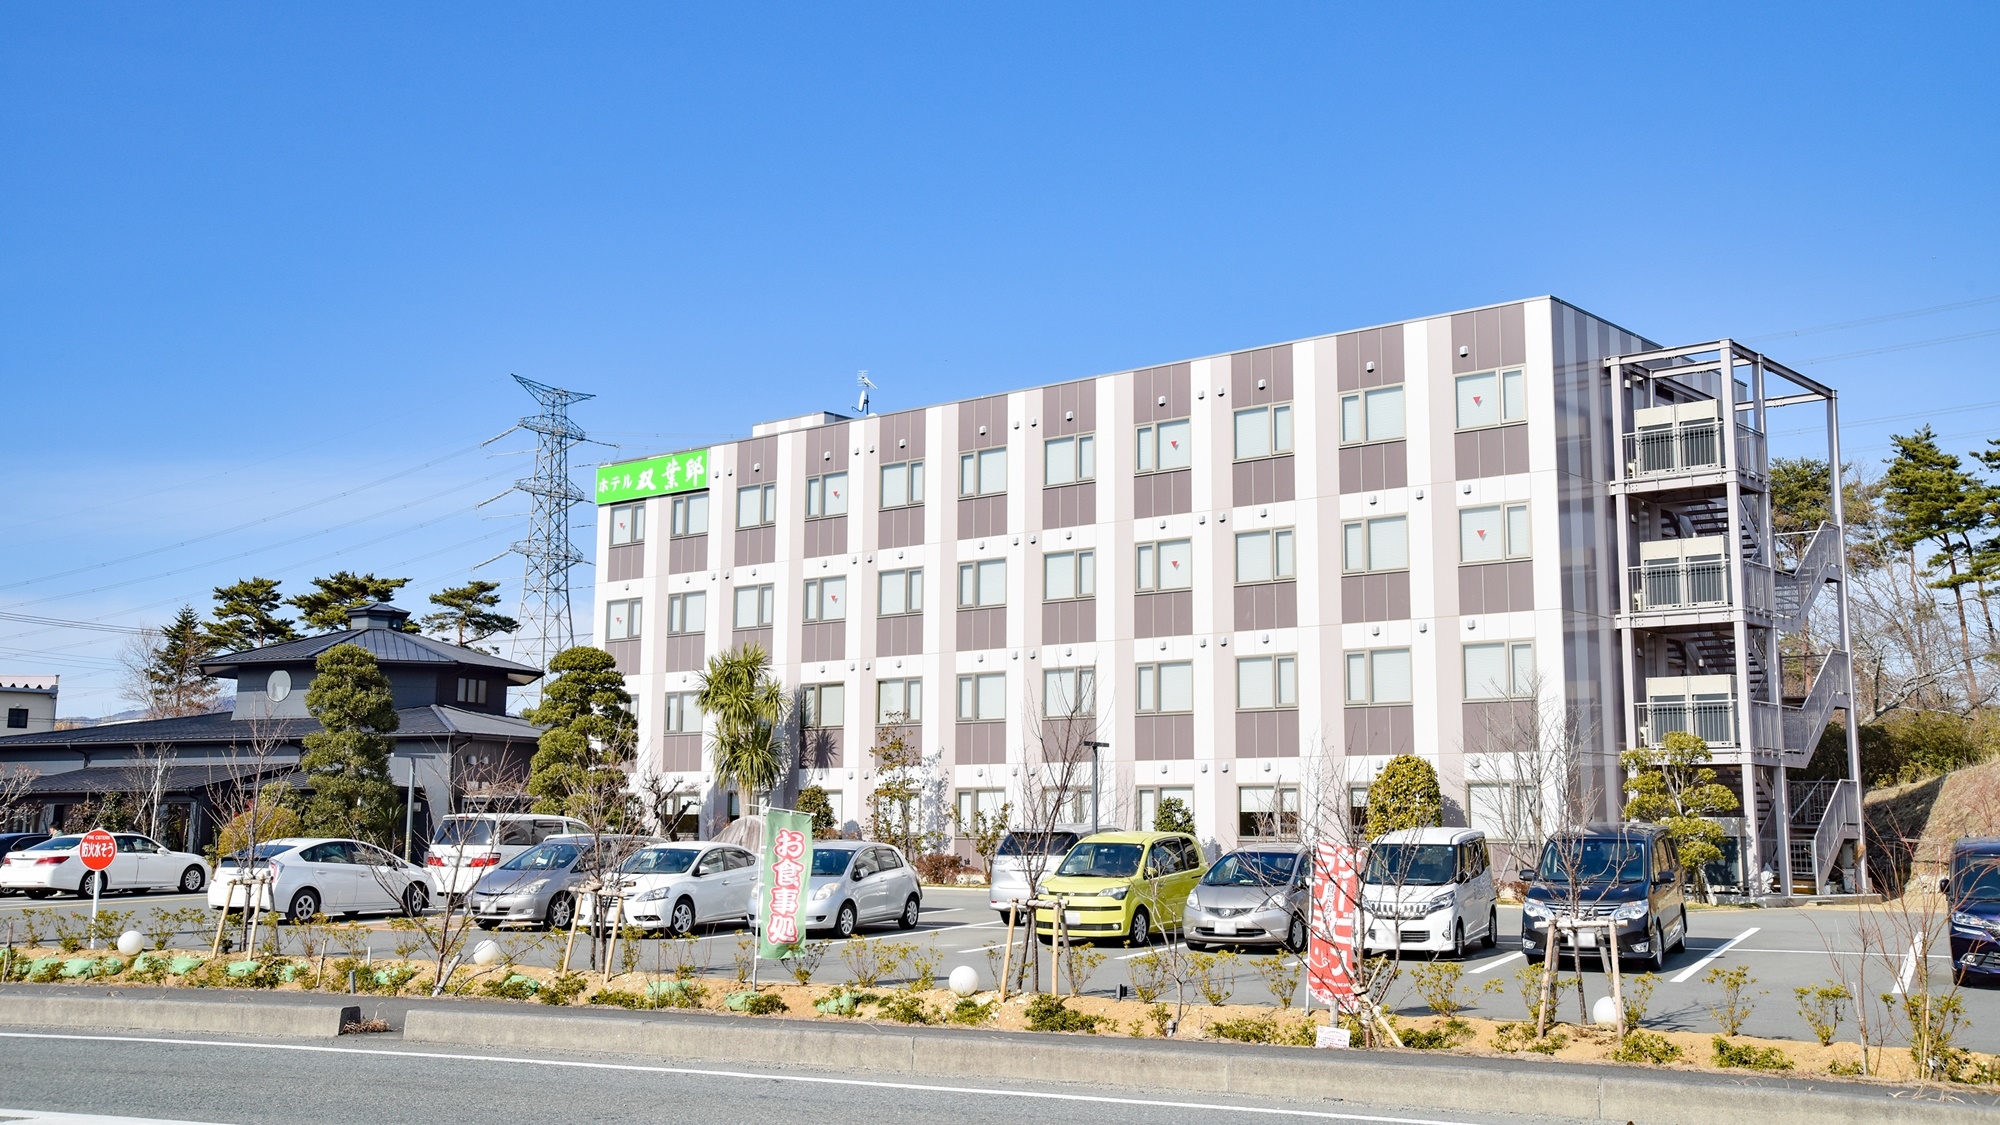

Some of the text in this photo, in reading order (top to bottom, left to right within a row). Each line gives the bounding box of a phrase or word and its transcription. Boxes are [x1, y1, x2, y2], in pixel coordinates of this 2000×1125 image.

[82, 842, 114, 857] 防火水そう
[767, 828, 805, 944] お食事処
